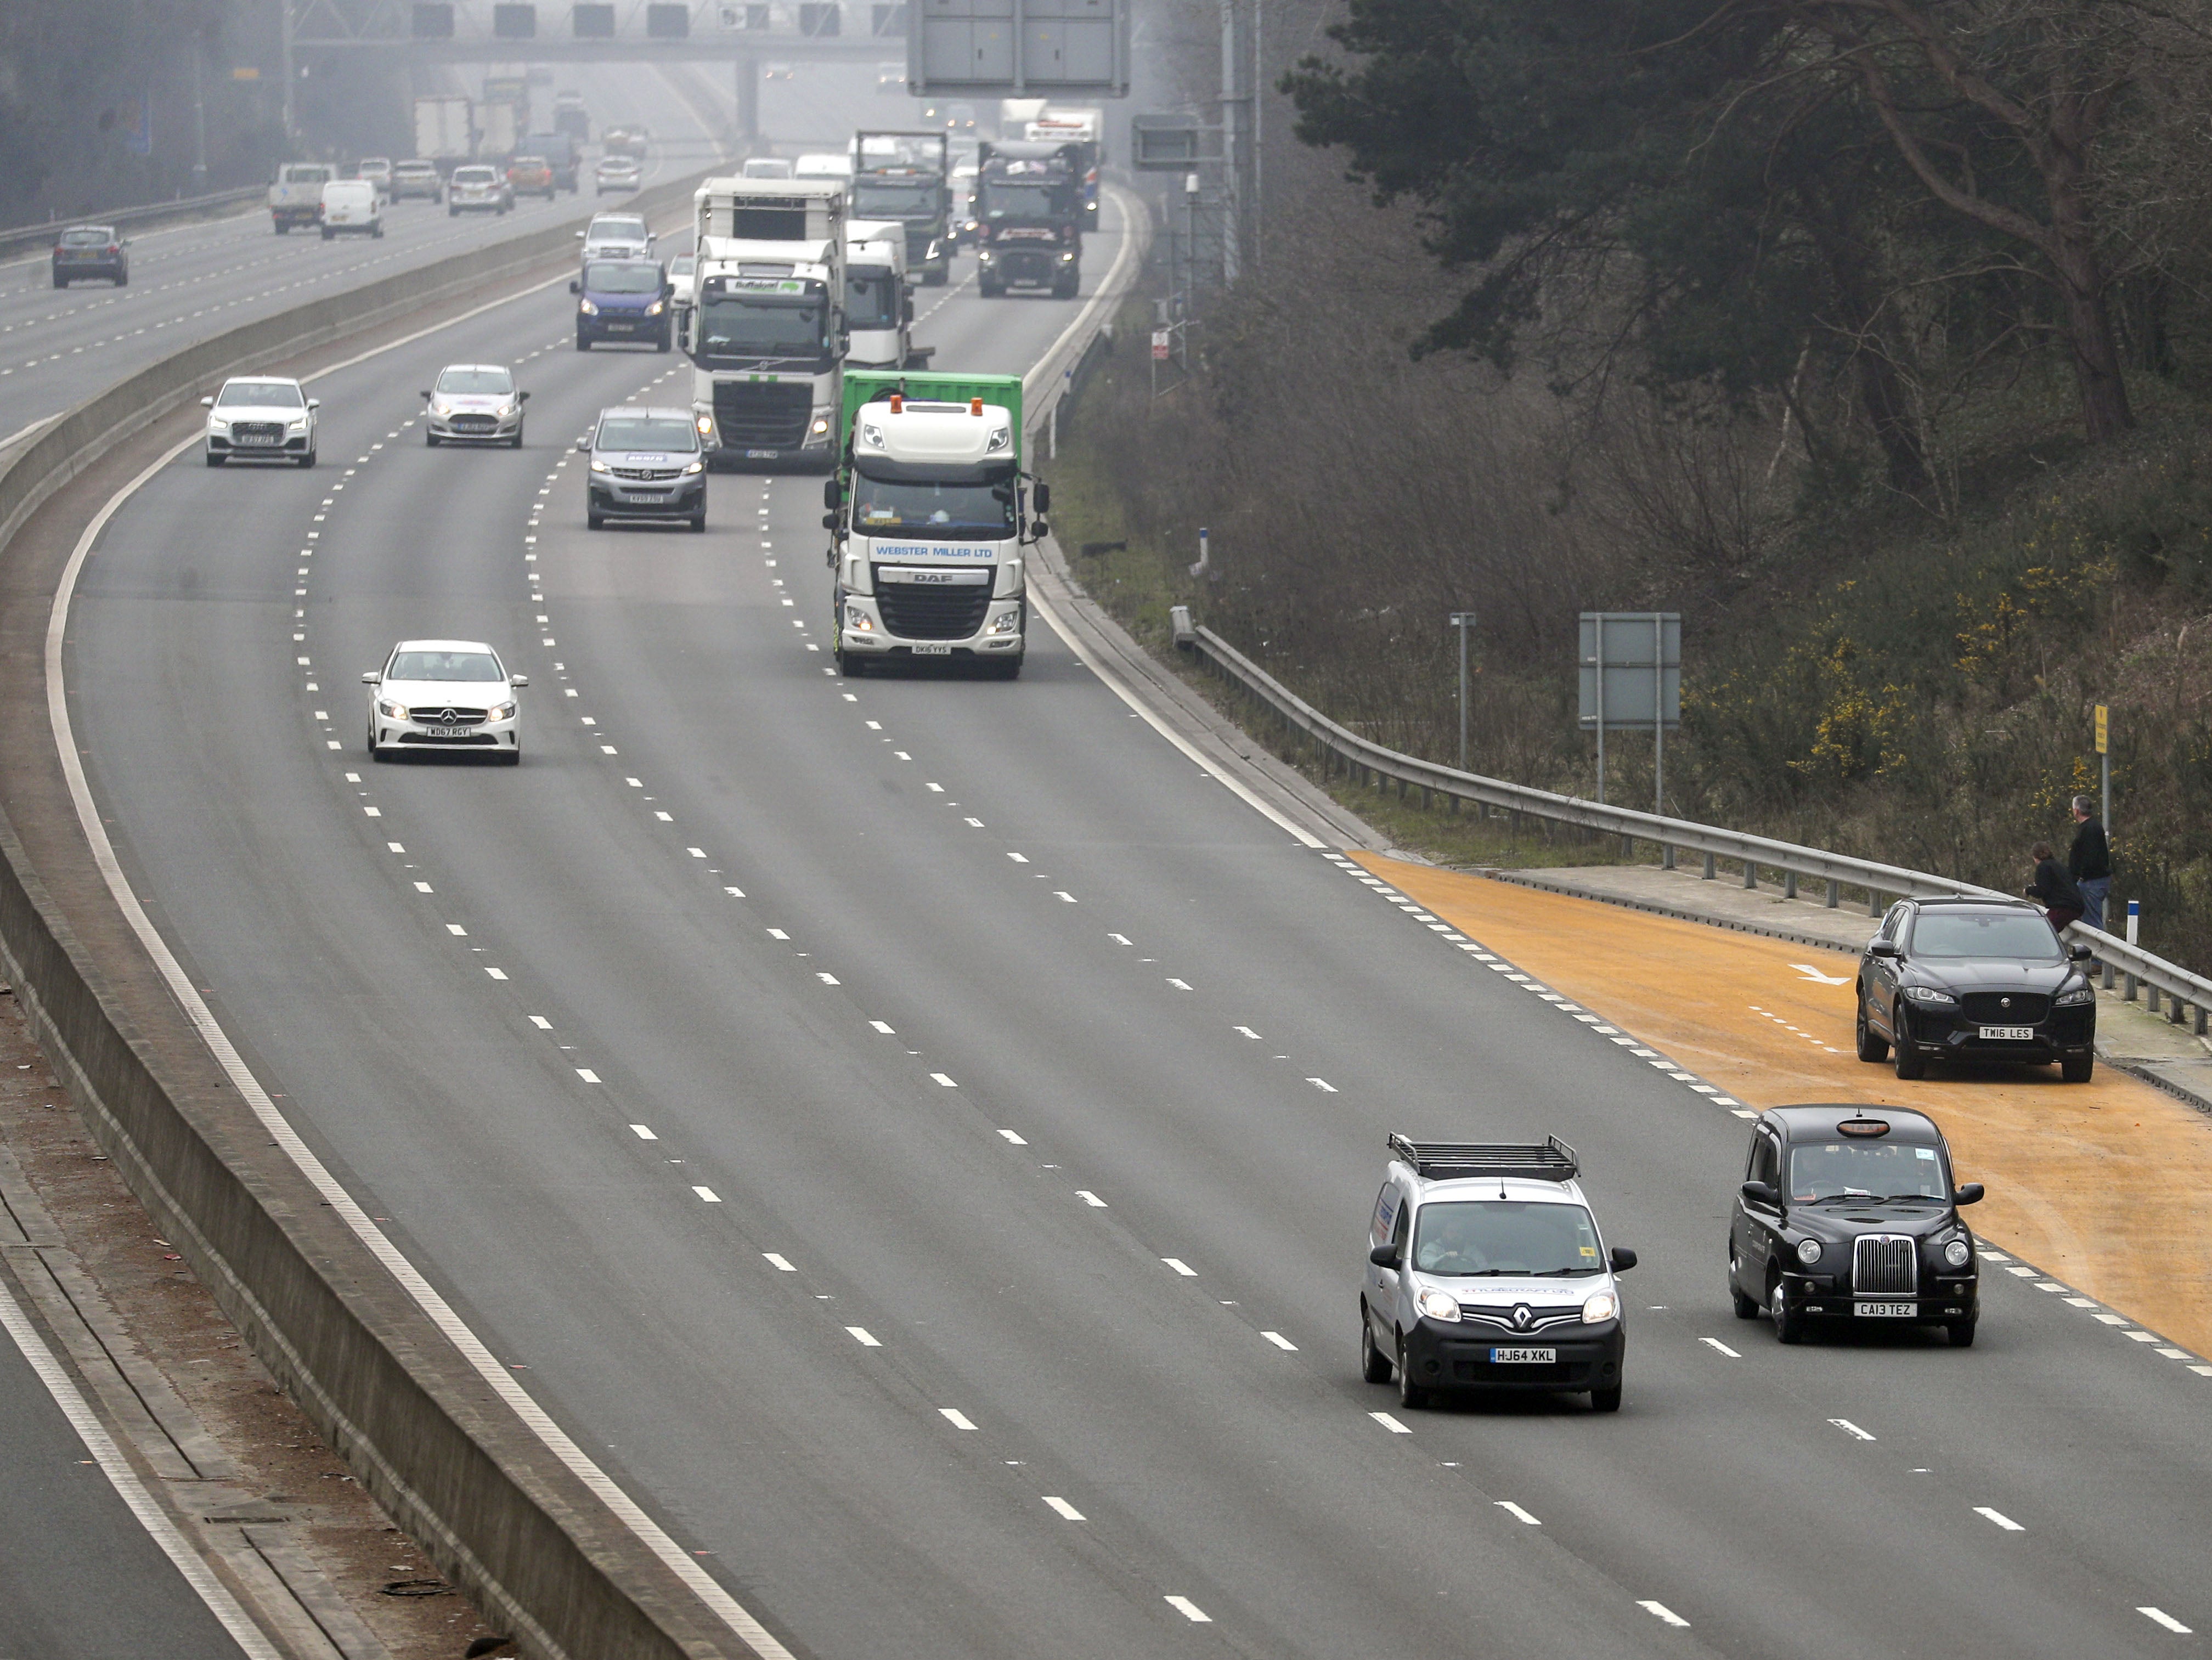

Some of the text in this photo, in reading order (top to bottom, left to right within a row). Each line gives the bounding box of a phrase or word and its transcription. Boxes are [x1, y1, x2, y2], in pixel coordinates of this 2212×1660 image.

[876, 546, 992, 558] WEBSTER MILLER LTD
[913, 574, 953, 583] DAF
[1984, 1028, 2029, 1038] TW16 LES
[1860, 1305, 1910, 1315] CA13 TEZ
[1497, 1350, 1553, 1361] HJ64 XKL
